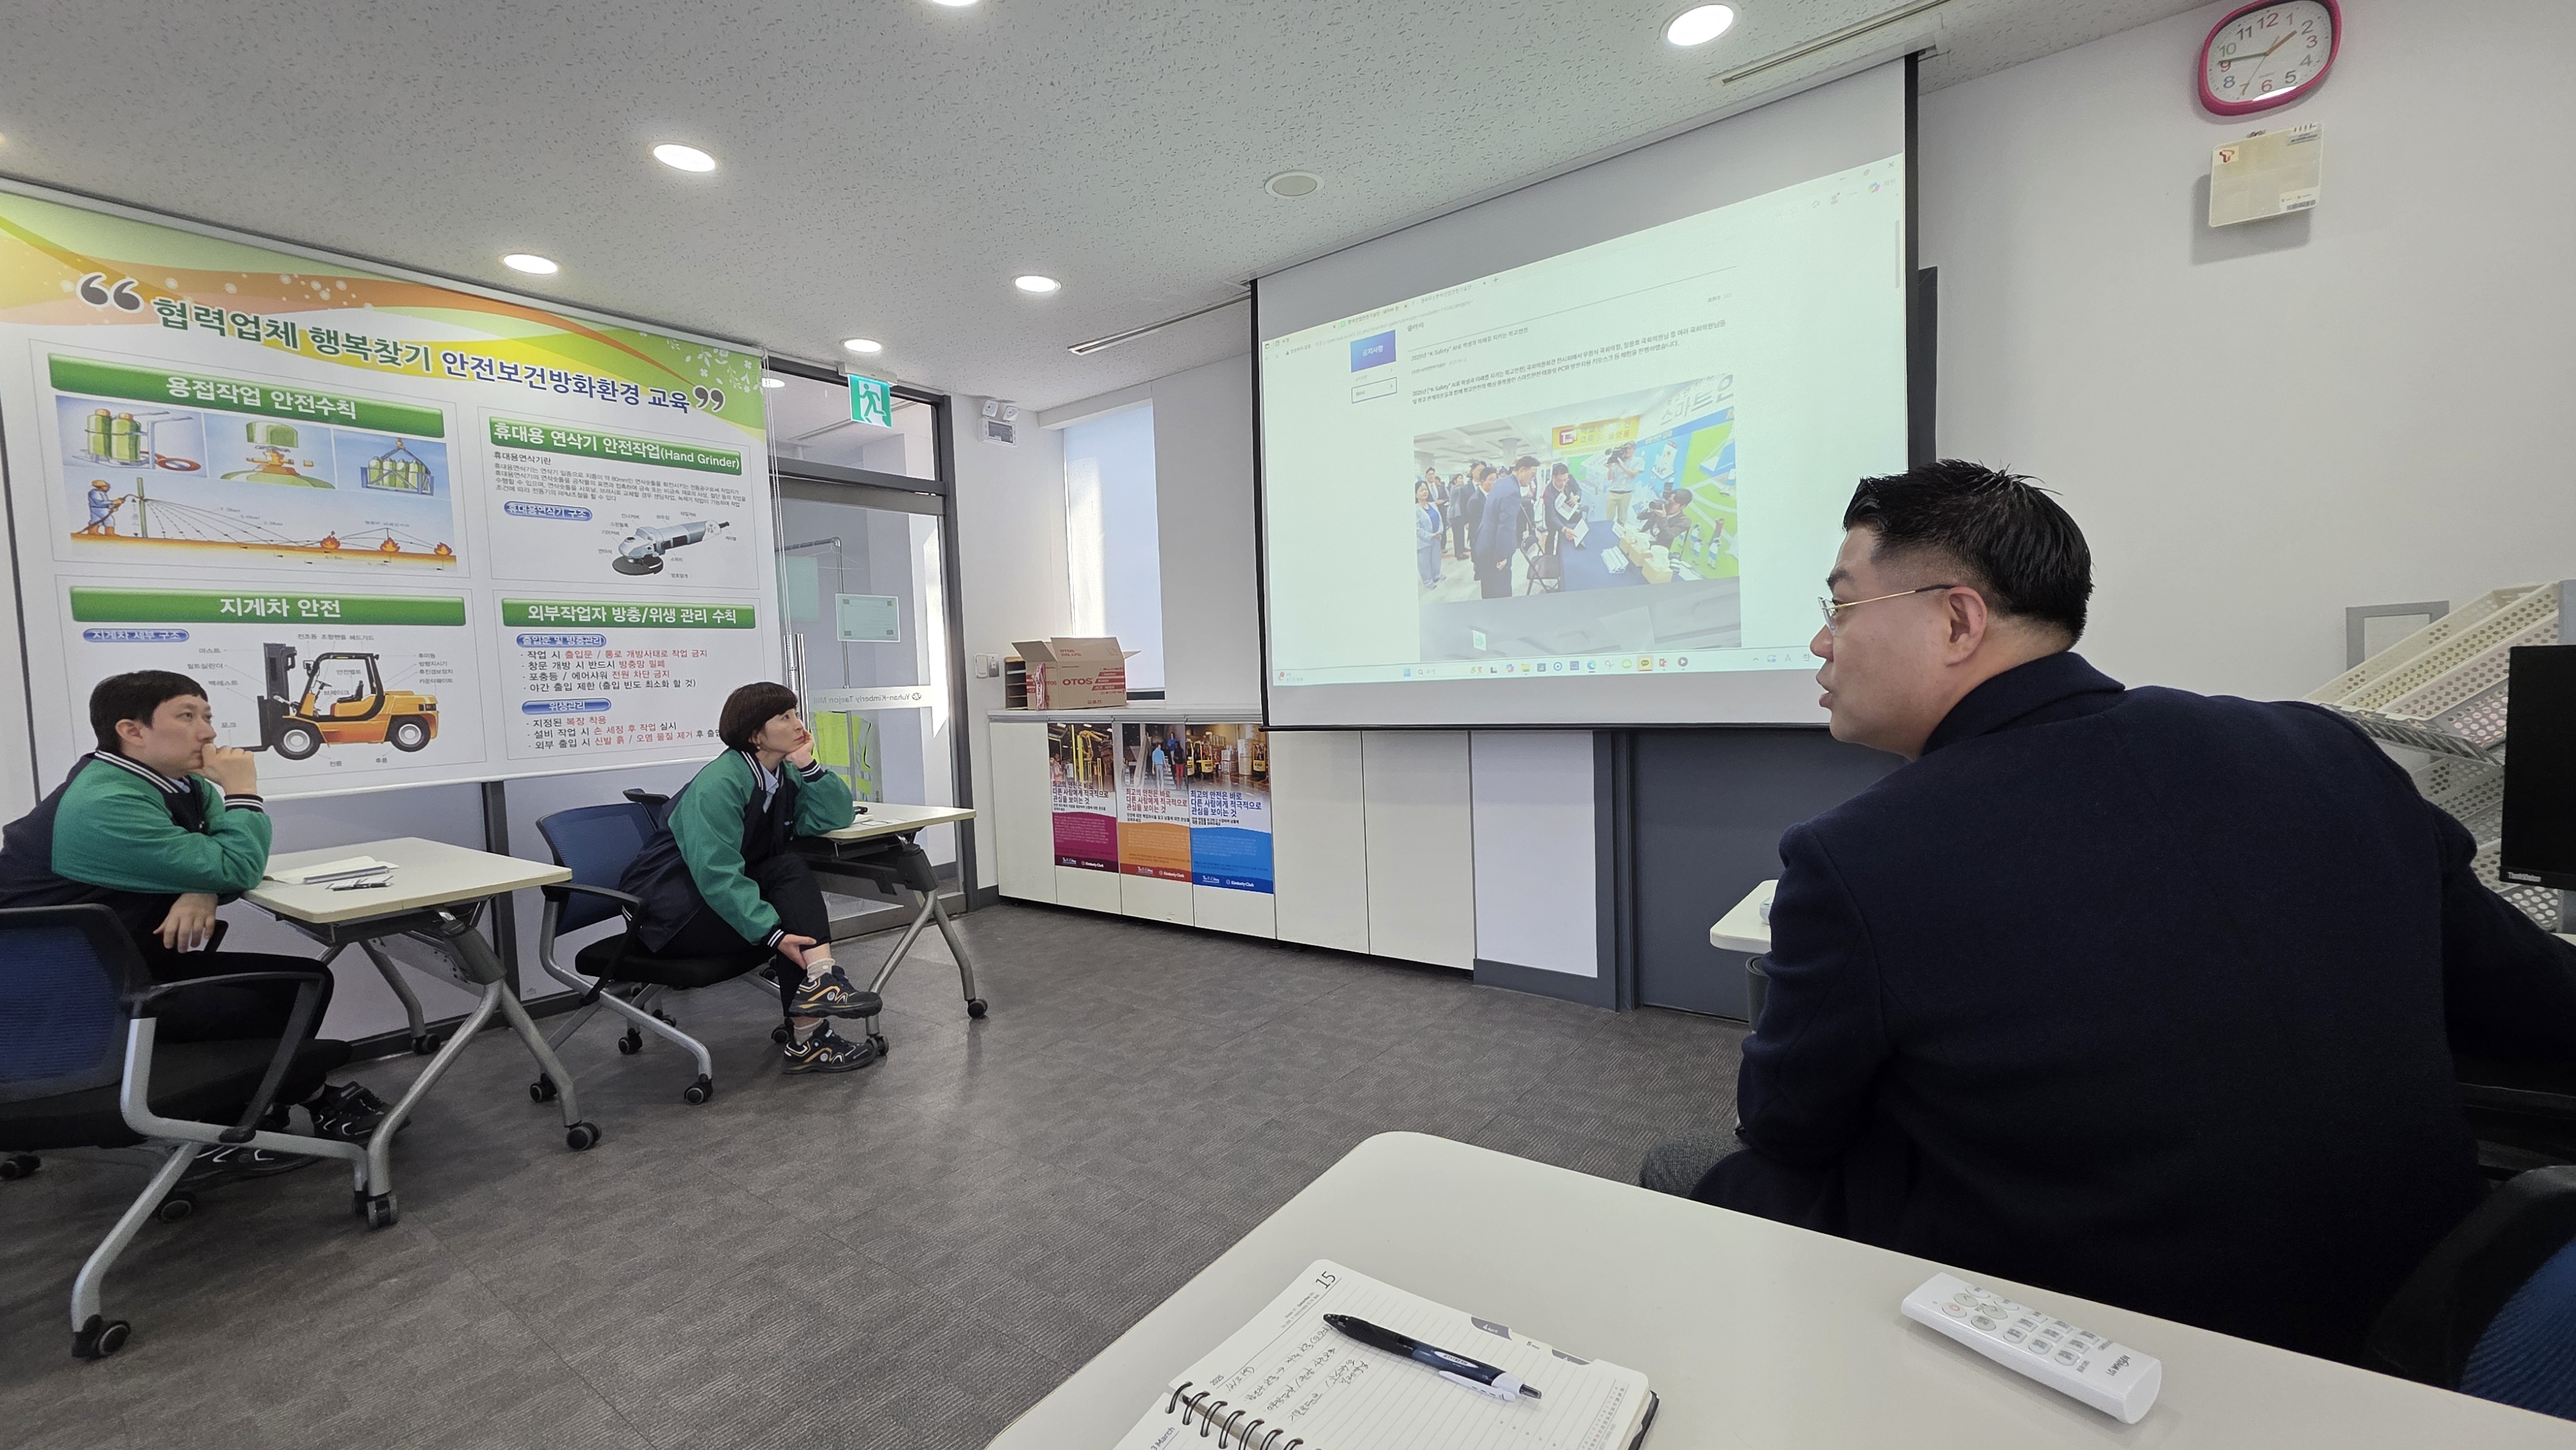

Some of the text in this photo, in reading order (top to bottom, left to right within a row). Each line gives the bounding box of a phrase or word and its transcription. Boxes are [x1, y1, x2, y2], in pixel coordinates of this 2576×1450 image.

[2257, 12, 2279, 30] 12
[2286, 12, 2293, 26] 1
[2237, 26, 2252, 40] 11
[2301, 19, 2313, 35] 2
[2306, 35, 2318, 49] 3
[2219, 42, 2237, 57] 10
[2220, 61, 2231, 72] 9
[2300, 54, 2313, 67] 4
[2223, 75, 2236, 89] 8
[2285, 70, 2297, 84] 5
[2239, 82, 2250, 96] 7
[2261, 79, 2273, 92] 6
[153, 298, 690, 414] 협력업체 행복찾기 안전보건방화환경 교육
[1362, 344, 1383, 357] 공지사항
[1411, 352, 1427, 361] 2025년
[166, 377, 356, 420] 용접작업 안전수칙
[494, 422, 740, 469] 휴대용 연삭기 안전작업(Hand Grinder)
[493, 451, 551, 466] 휴대용연삭기란
[508, 504, 587, 518] 휴대용연삭기 구조
[220, 598, 341, 617] 지게차 안전
[528, 605, 736, 624] 외부작업자 방충/위생 관리 수칙
[93, 630, 181, 640] 지게차 세부 구조
[522, 636, 601, 645] 출입문 및 방충관리
[527, 651, 546, 659] 작업
[565, 650, 593, 659] 출입문
[605, 650, 622, 659] 통로
[692, 649, 707, 657] 금지
[529, 661, 547, 671] 창문
[553, 661, 571, 670] 개방
[576, 661, 584, 670] 시
[589, 661, 615, 669] 반드시
[619, 660, 645, 669] 방충망
[529, 670, 670, 681] 포충등 에어샤워 전원 차단 금지
[530, 679, 696, 692] 야간 출입 제한 (출입 빈도 최소화 할 것)
[549, 701, 585, 711] 위생관리
[533, 715, 607, 728] 지정된 복장 착용
[534, 729, 553, 739] 설비
[558, 728, 576, 737] 작업
[594, 726, 602, 735] 손
[607, 725, 623, 734] 세정
[628, 724, 636, 733] 후
[639, 723, 656, 731] 작업
[660, 722, 677, 731] 실시
[535, 740, 554, 749] 외부
[558, 739, 577, 748] 출입
[595, 737, 612, 746] 신발
[637, 733, 653, 742] 오염
[657, 732, 673, 741] 물질
[677, 731, 693, 739] 제거
[1138, 796, 1159, 805] 사람에게
[1160, 798, 1188, 807] 적극적으로
[1191, 790, 1242, 800] 최고의 안전은 바로
[1191, 798, 1262, 810] 다른 사람에게 적극적으로
[1191, 807, 1209, 816] 관심을
[1211, 808, 1229, 817] 보이는
[1315, 1270, 1336, 1289] 15
[1443, 1354, 1468, 1366] JETSTREAM
[2105, 1354, 2131, 1377] LG WHISEN
[1209, 1374, 1224, 1386] 2025
[1155, 1427, 1175, 1446] March
